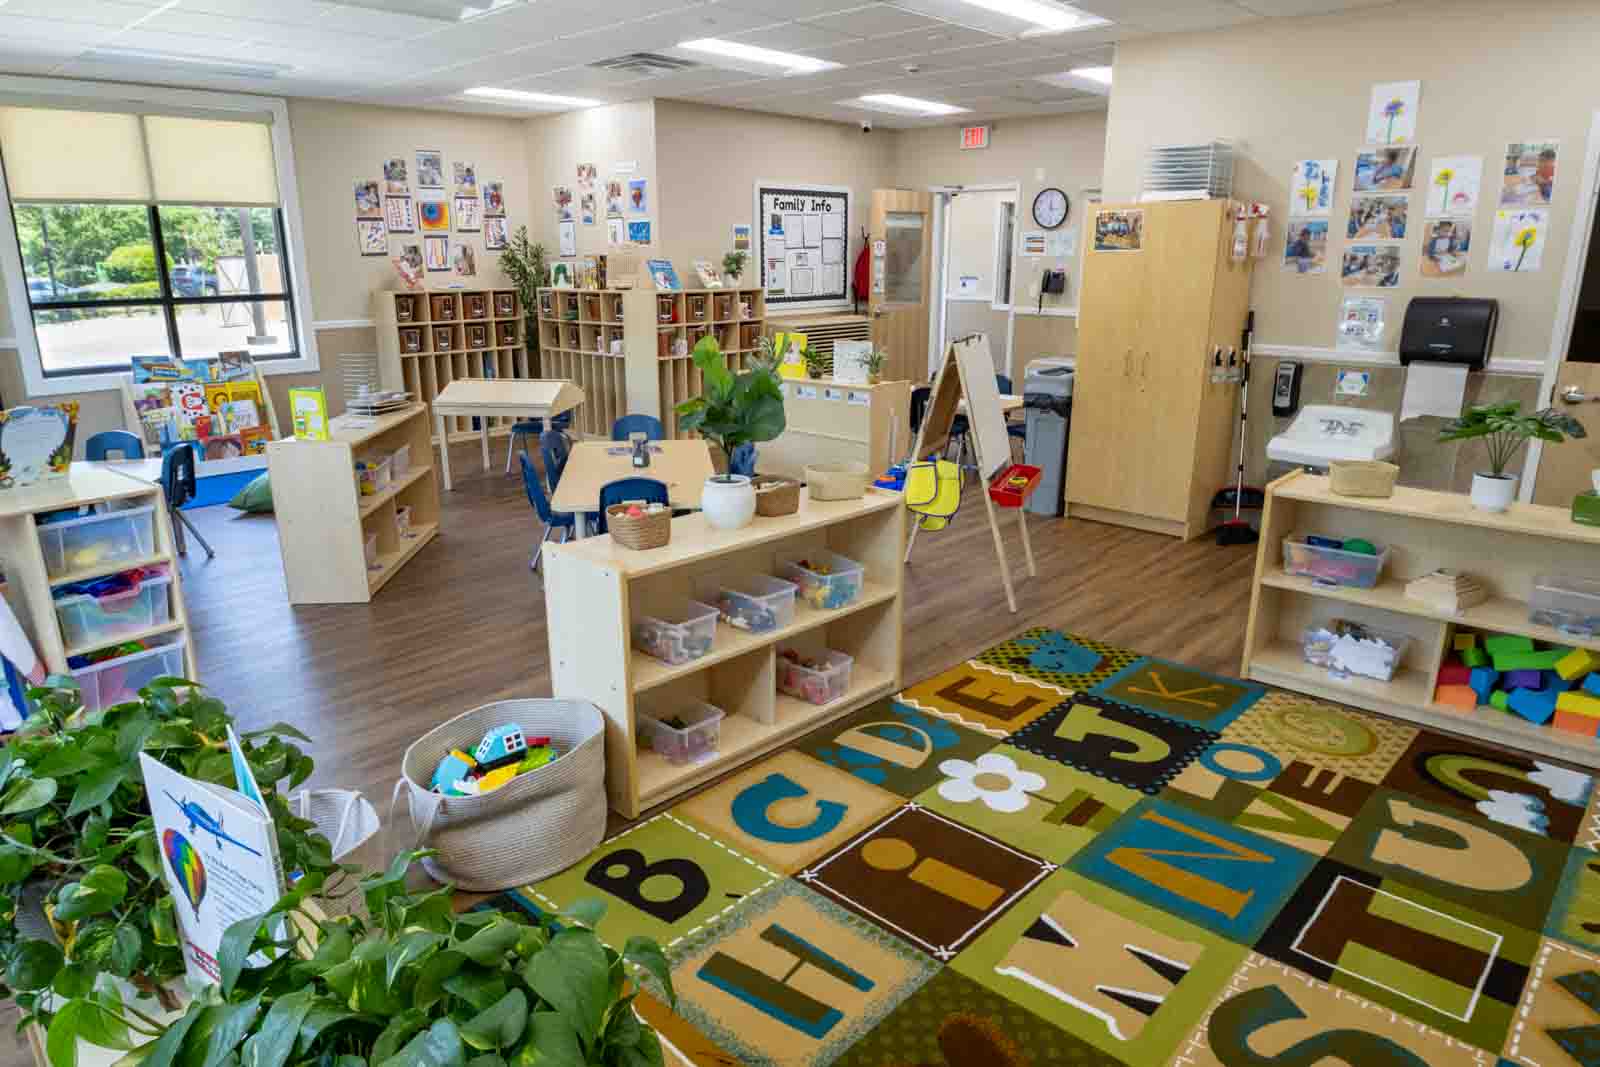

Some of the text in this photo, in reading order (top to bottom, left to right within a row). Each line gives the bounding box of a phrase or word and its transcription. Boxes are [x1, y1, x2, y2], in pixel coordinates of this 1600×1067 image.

[964, 128, 984, 145] EXIT
[773, 198, 832, 212] Family Info
[935, 676, 1050, 721] E
[1128, 671, 1225, 709] K
[1054, 703, 1170, 762] J
[731, 772, 848, 843] C
[1104, 810, 1274, 918] N
[1371, 799, 1532, 891] U
[584, 849, 710, 924] B
[697, 923, 876, 1039] H
